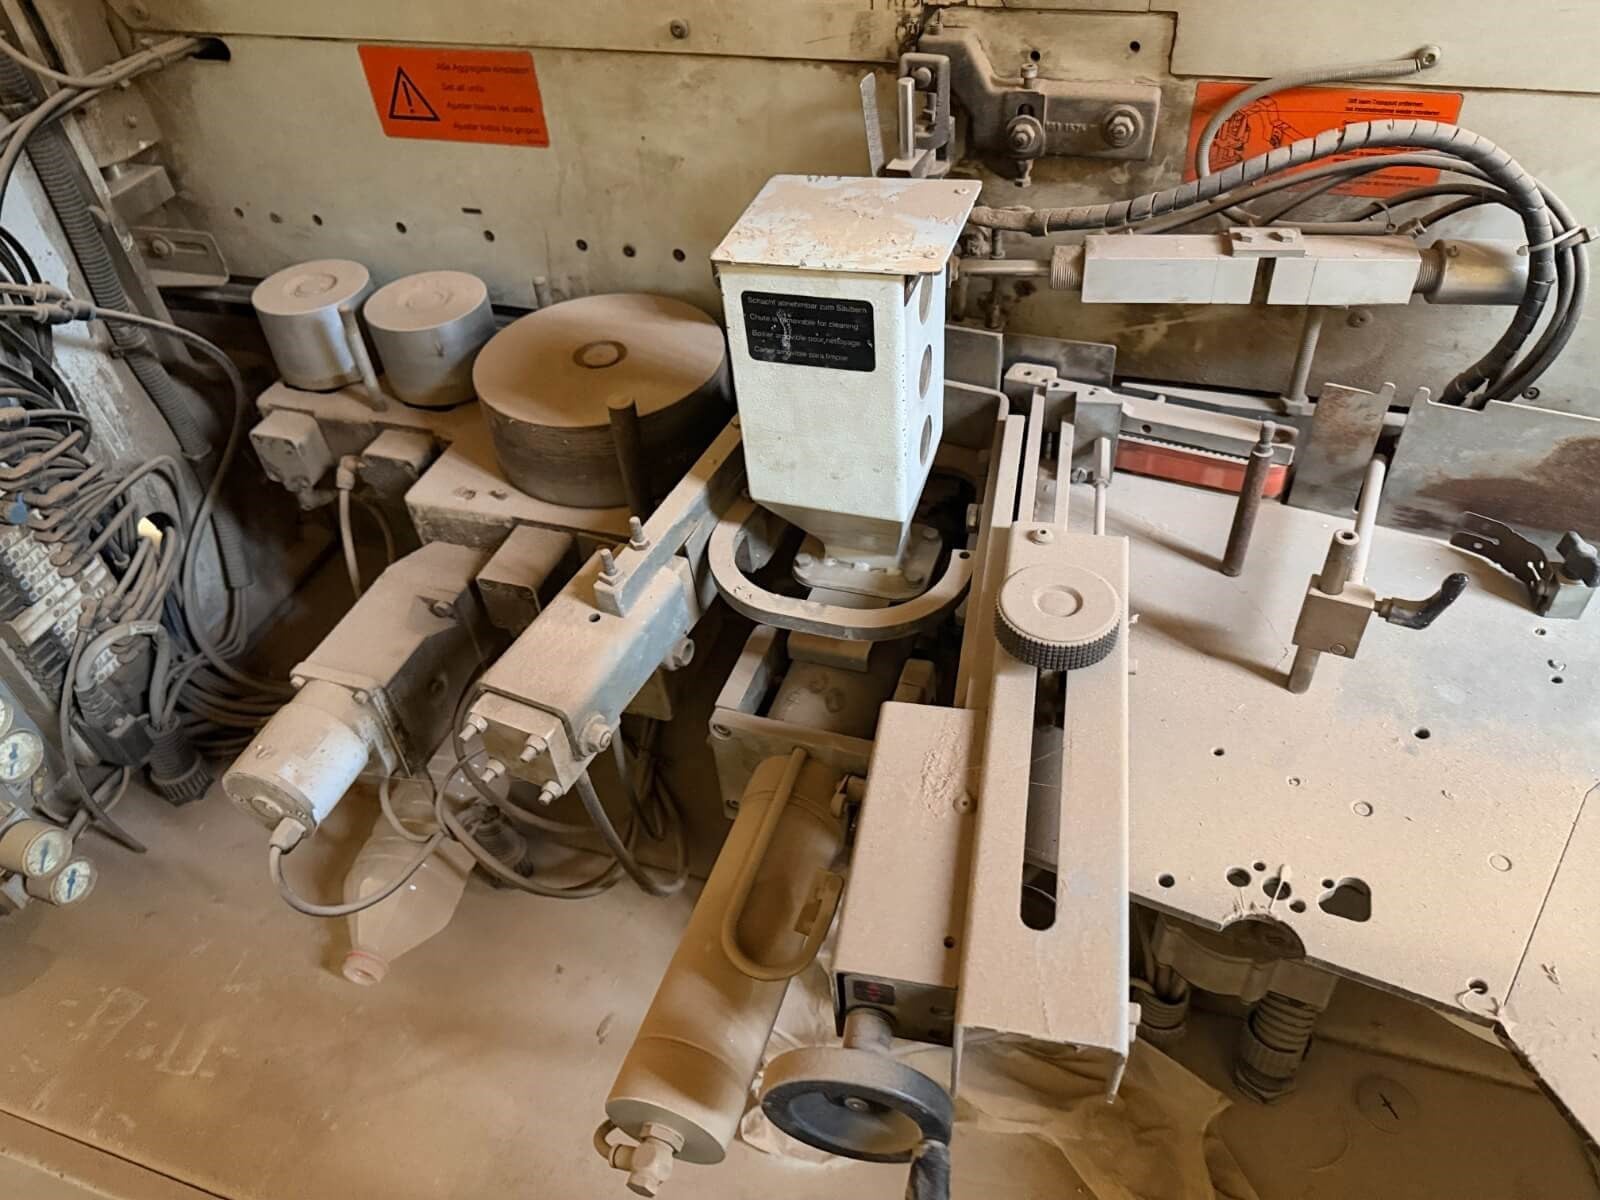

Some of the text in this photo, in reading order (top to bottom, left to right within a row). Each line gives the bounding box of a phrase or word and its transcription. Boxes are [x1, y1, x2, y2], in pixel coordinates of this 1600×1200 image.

[819, 303, 835, 311] zum
[749, 313, 771, 322] Chute
[817, 319, 829, 327] for
